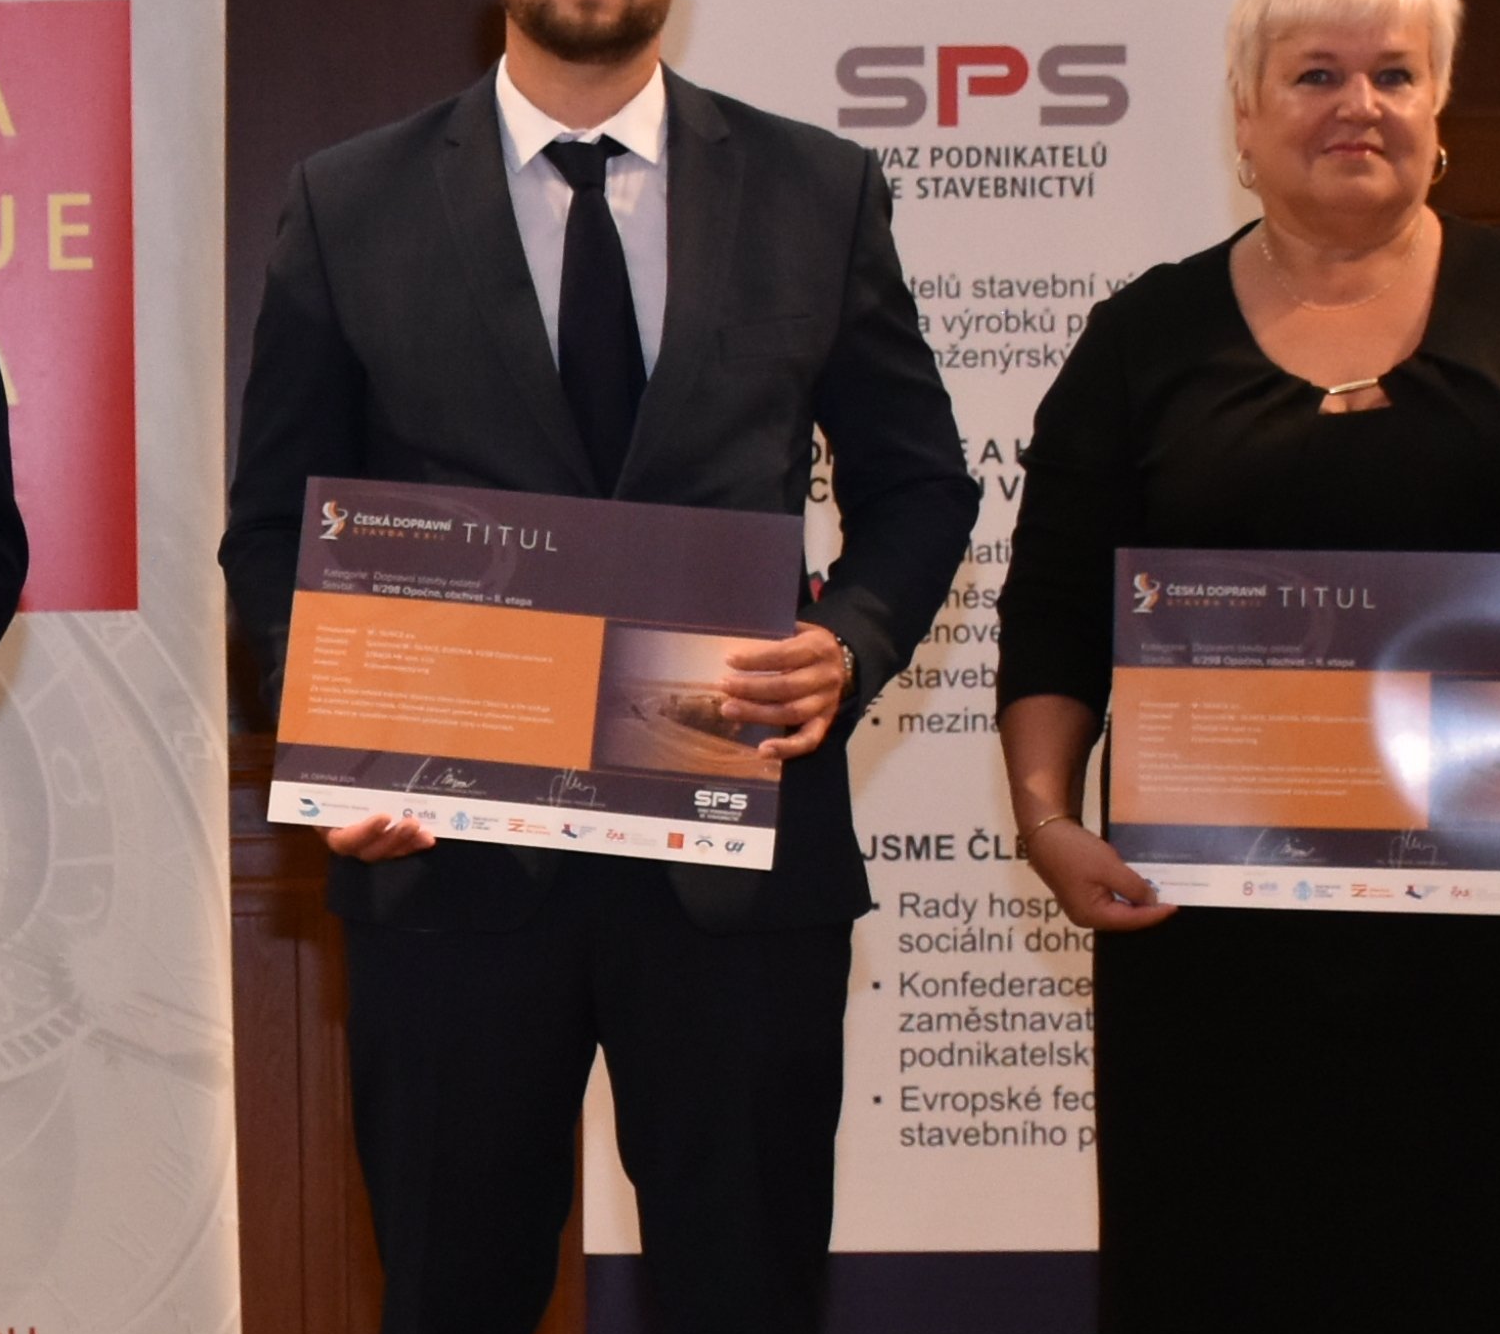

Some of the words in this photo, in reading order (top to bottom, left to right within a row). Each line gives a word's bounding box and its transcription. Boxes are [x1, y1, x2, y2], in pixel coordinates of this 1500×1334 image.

[835, 44, 1130, 128] SPS
[930, 141, 1107, 168] PODNIKATELŮ
[916, 172, 1095, 199] STAVEBNICTVÍ
[971, 272, 1095, 299] stavební
[942, 307, 1055, 340] výrobků
[462, 522, 558, 552] TITUL
[1277, 586, 1376, 609] TITUL
[694, 789, 748, 810] SPS
[862, 834, 955, 861] JSME
[900, 892, 978, 924] Rady
[899, 926, 1014, 953] sociální
[900, 971, 1093, 998] Konfederace
[900, 1085, 1042, 1117] Evropské
[900, 1120, 1067, 1147] stavebního
